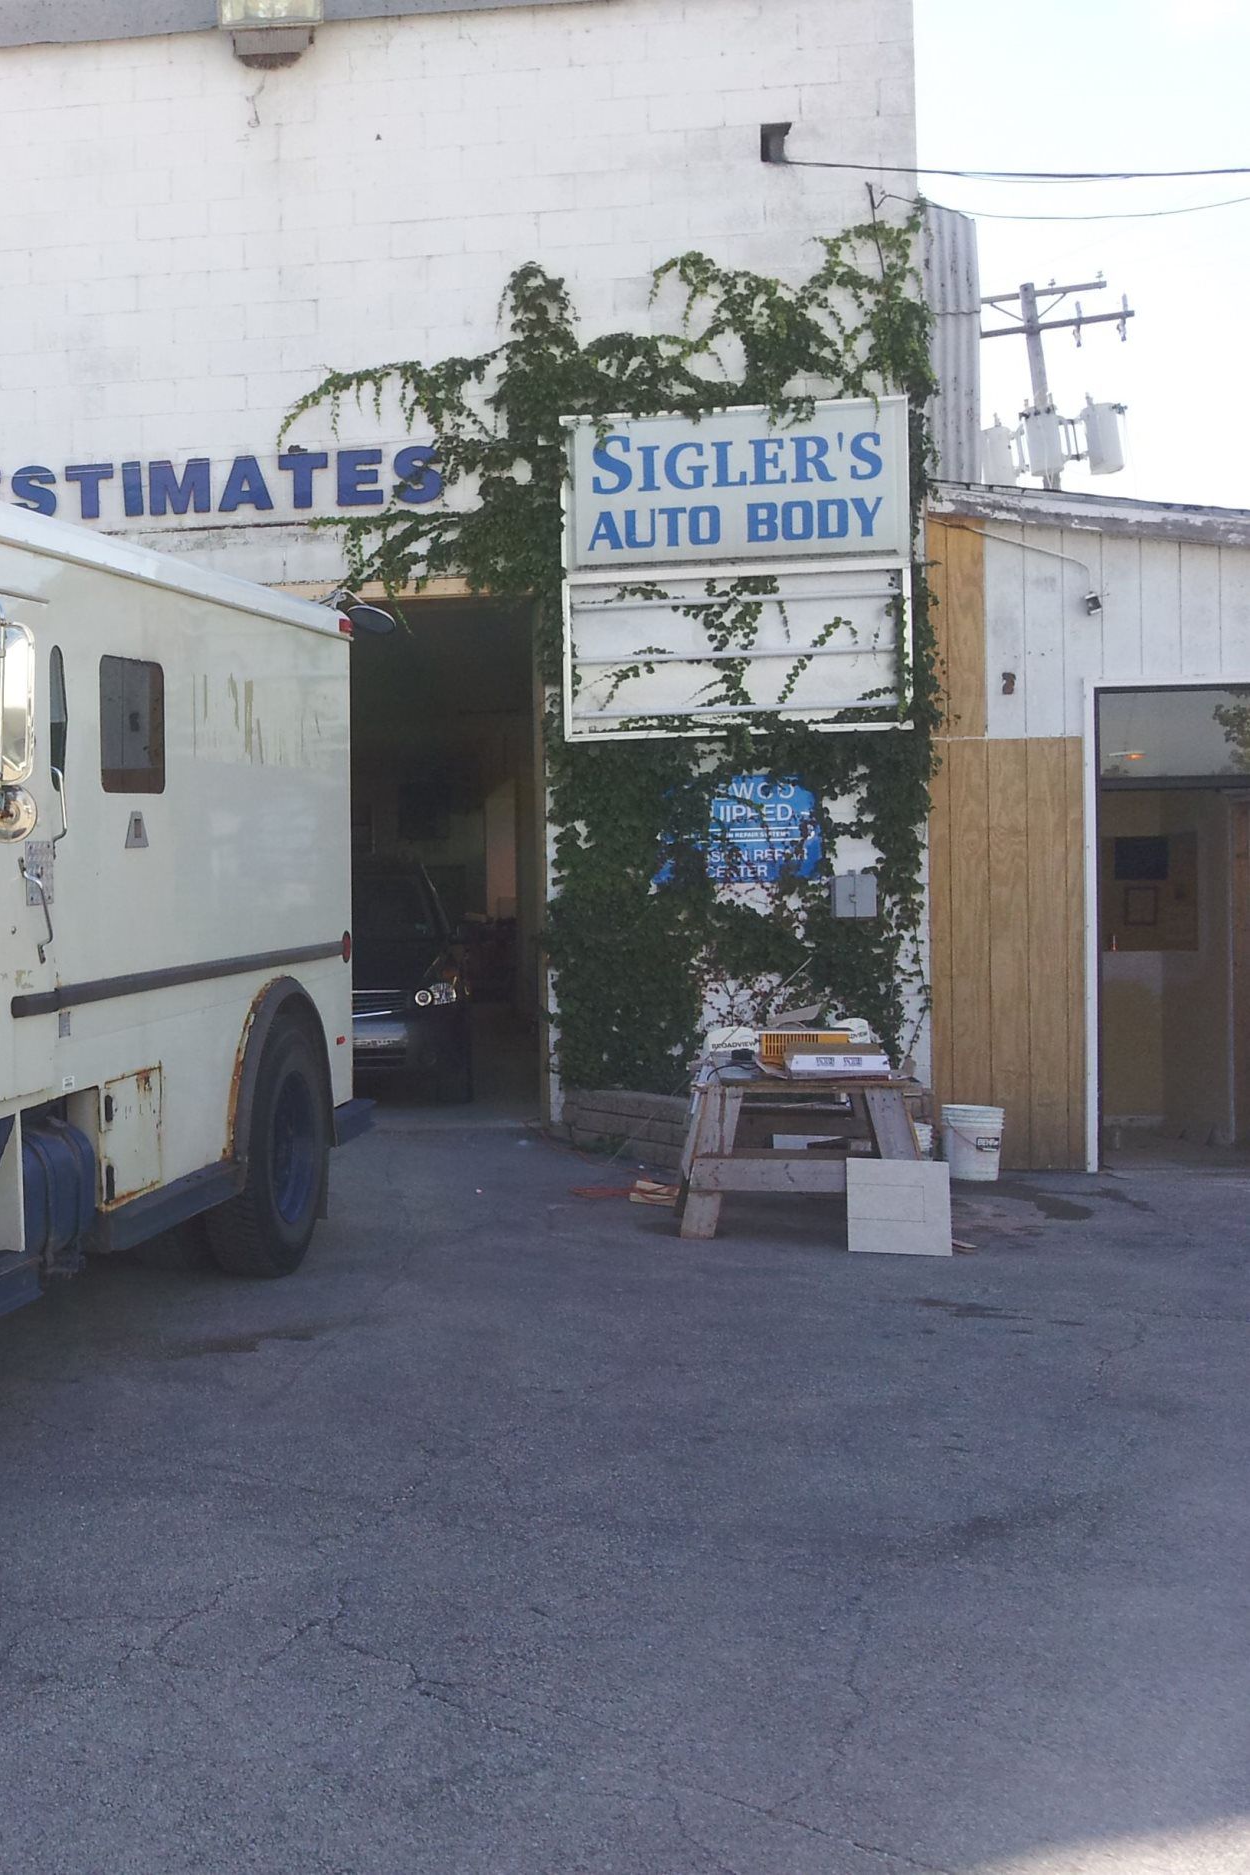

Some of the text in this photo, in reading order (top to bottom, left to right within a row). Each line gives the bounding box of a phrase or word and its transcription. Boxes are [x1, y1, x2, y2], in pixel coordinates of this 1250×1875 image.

[592, 432, 883, 495] SIGLER'S
[588, 497, 883, 551] AUTO BODY
